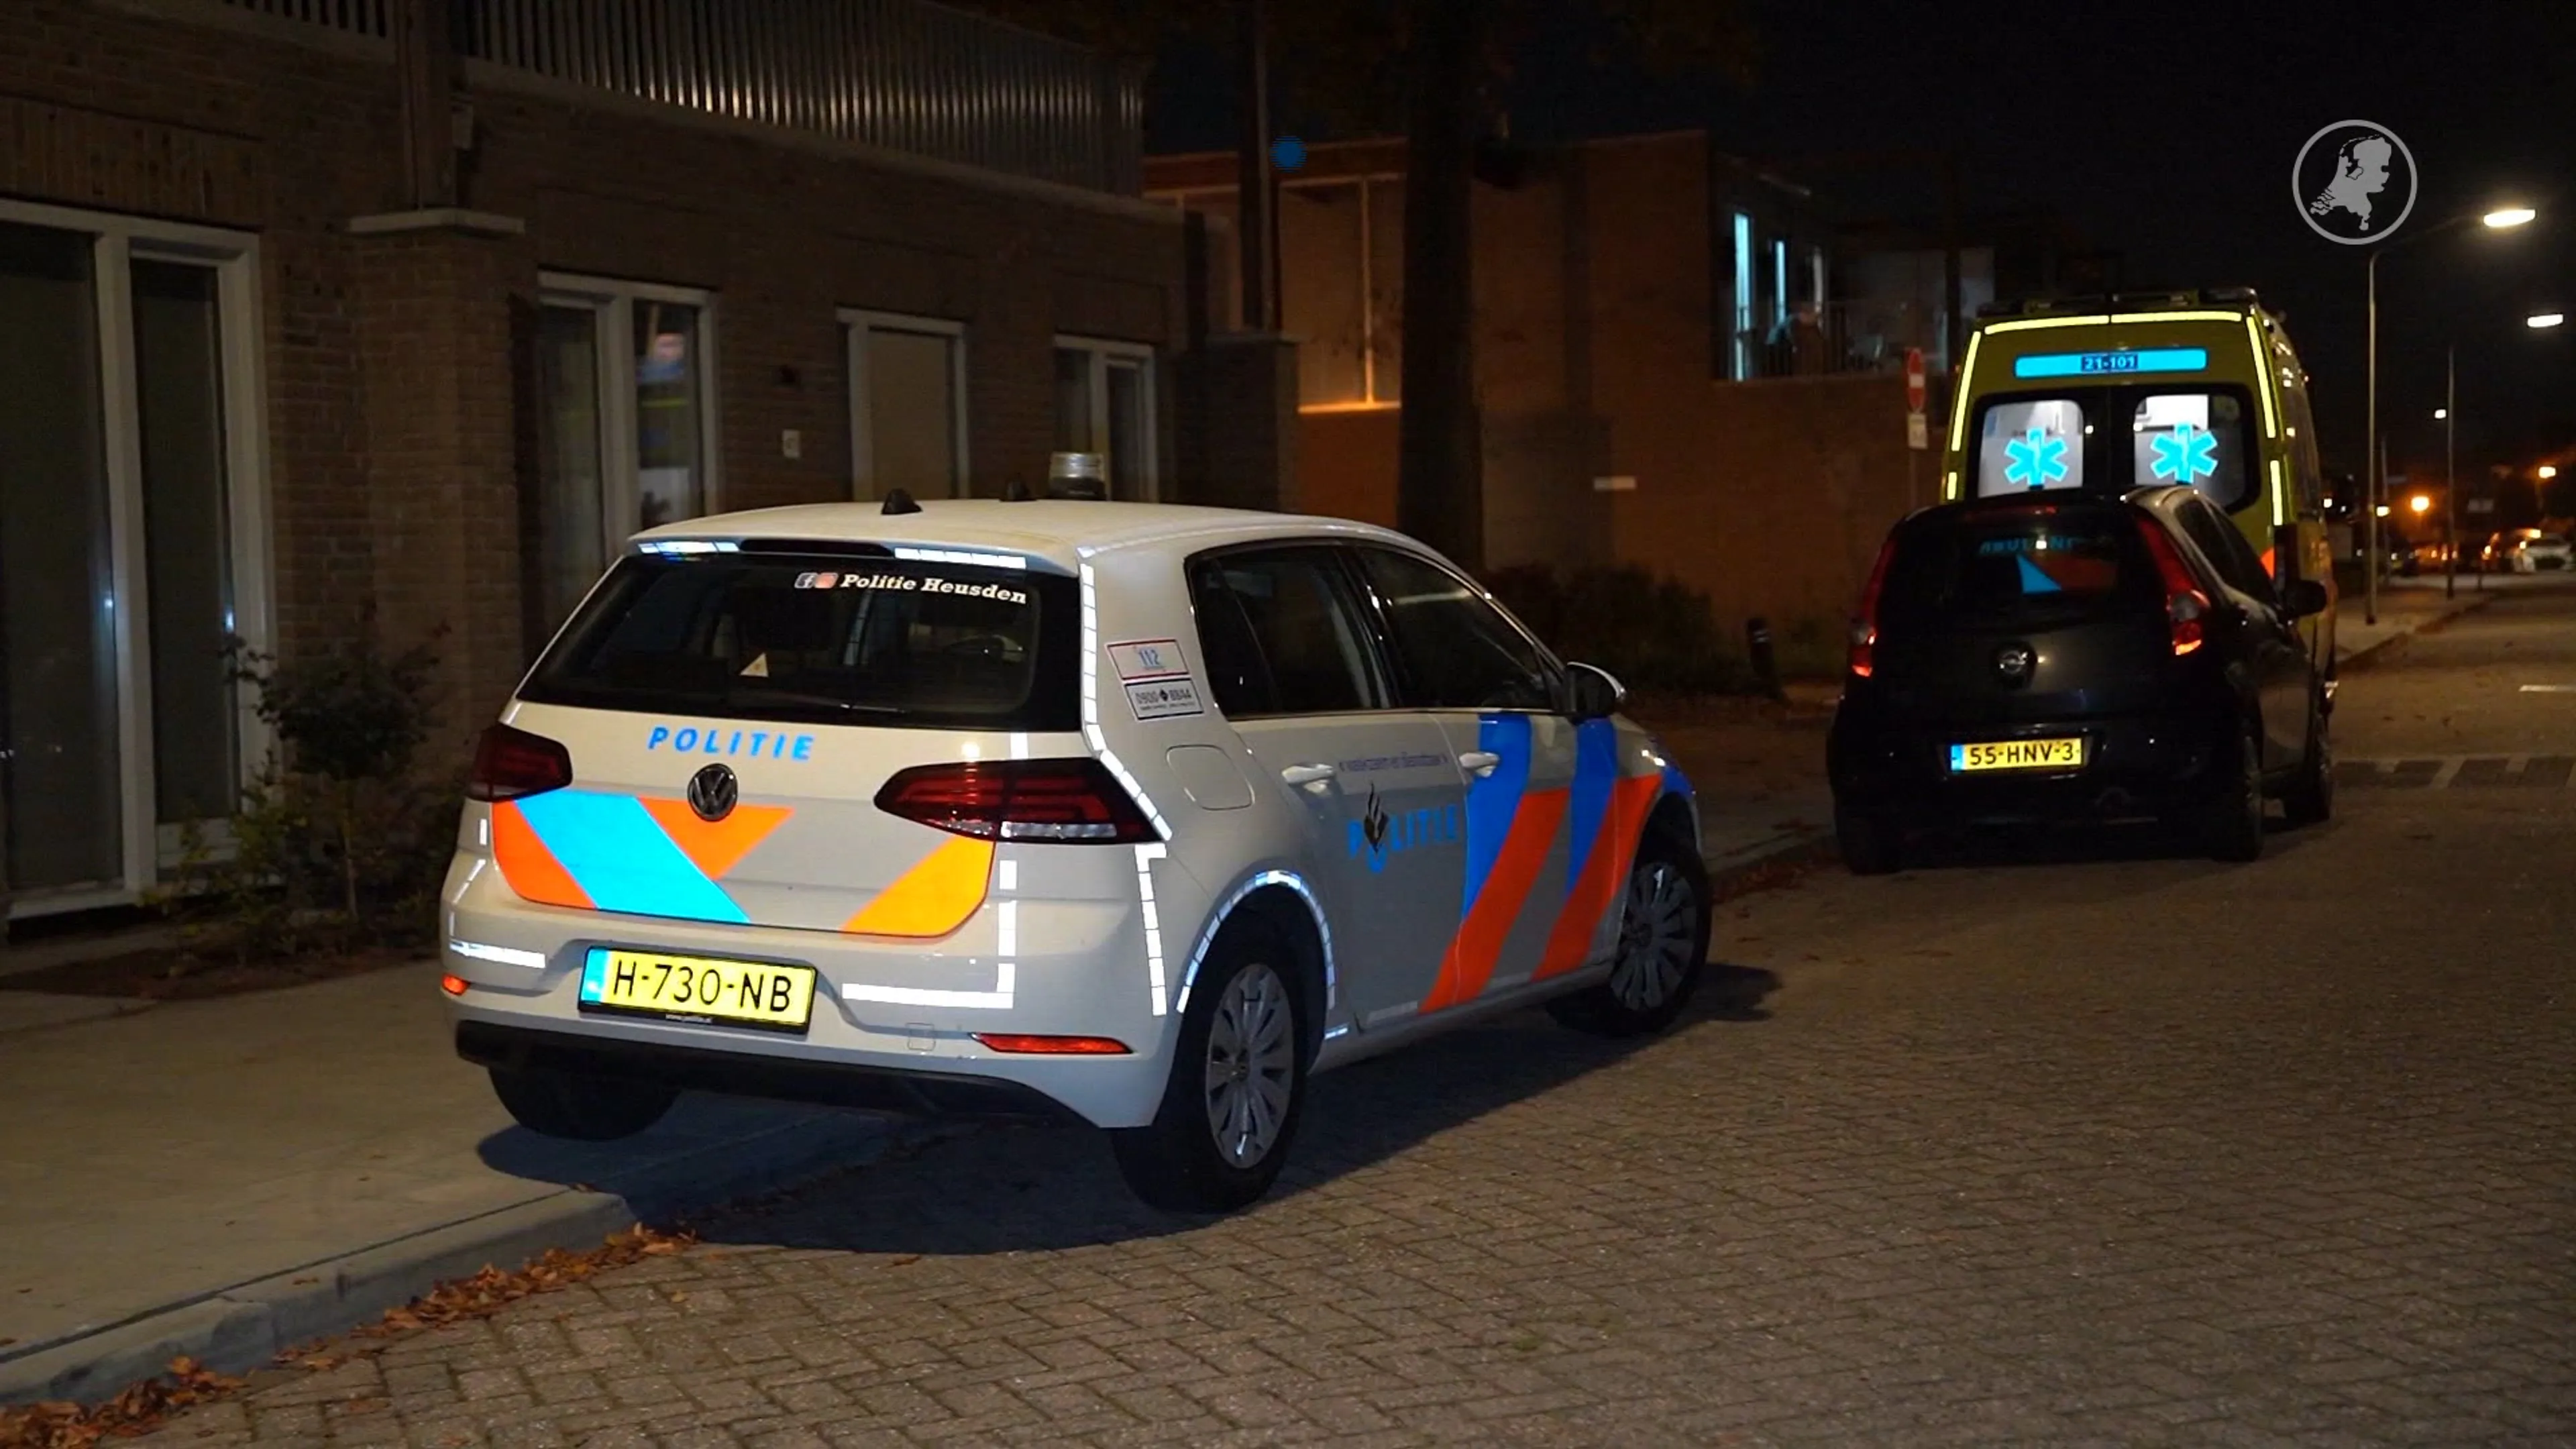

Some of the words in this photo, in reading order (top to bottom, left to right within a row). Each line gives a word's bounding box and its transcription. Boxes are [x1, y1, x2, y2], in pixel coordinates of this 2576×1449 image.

[2084, 356, 2135, 370] 21-101
[841, 574, 916, 590] Politie
[920, 578, 1026, 604] Heusden
[648, 727, 814, 761] POLITIE
[1970, 742, 2073, 765] 55-HNV-3
[613, 960, 792, 1012] H-730-NB
